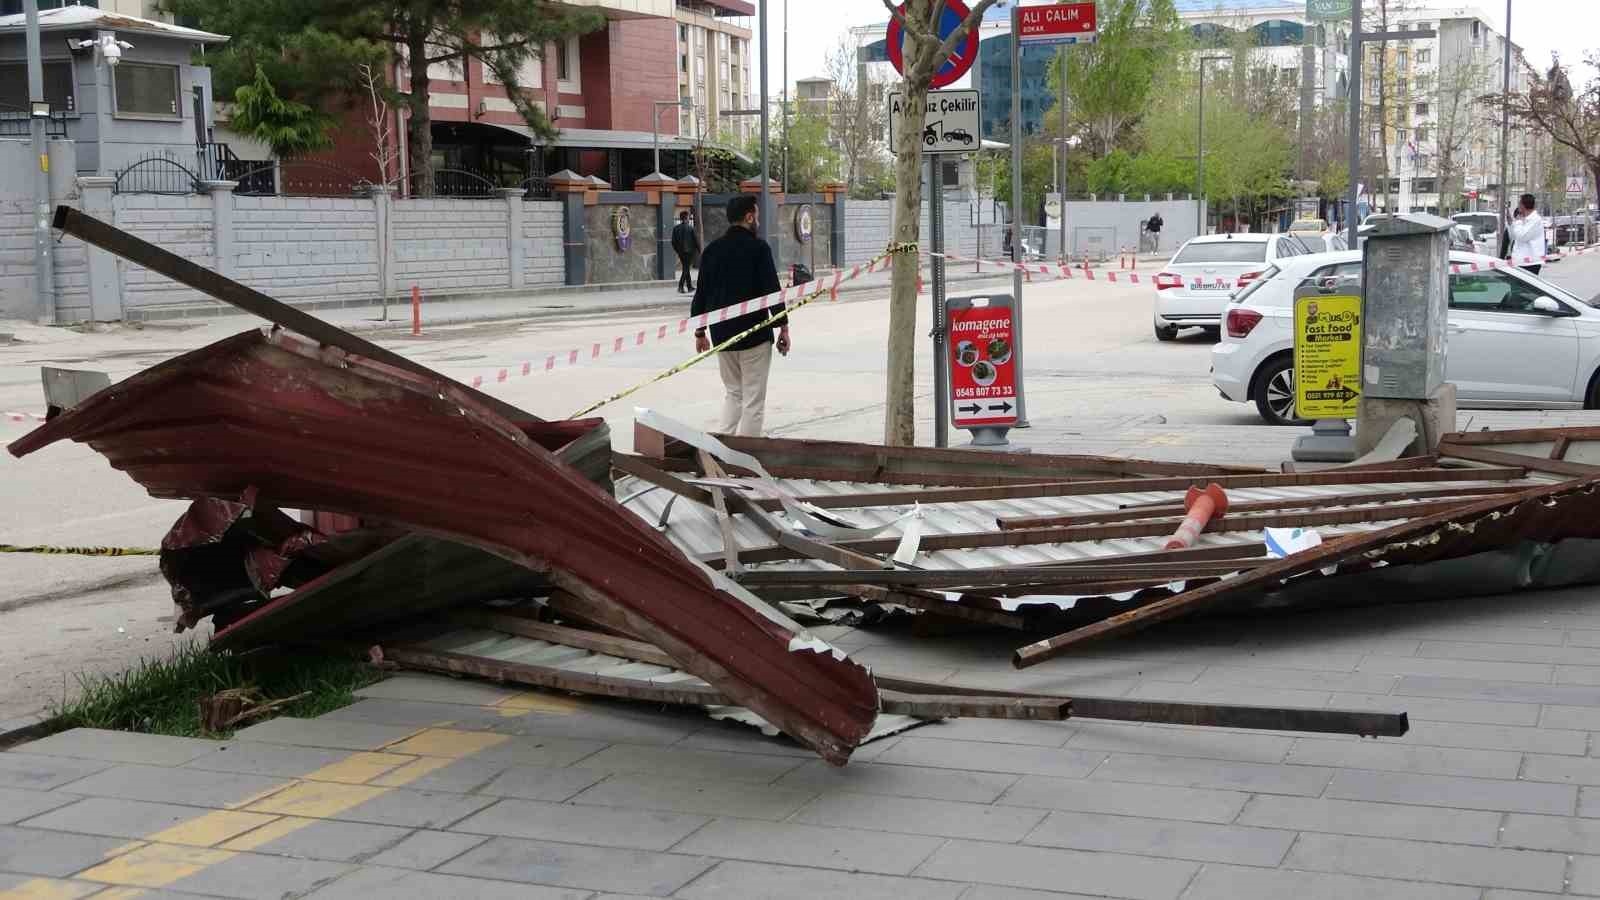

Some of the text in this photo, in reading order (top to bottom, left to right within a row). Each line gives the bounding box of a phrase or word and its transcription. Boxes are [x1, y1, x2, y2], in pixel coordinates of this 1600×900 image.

[940, 98, 977, 115] Çekilir
[952, 318, 1010, 334] komagene
[1305, 323, 1352, 333] fast food
